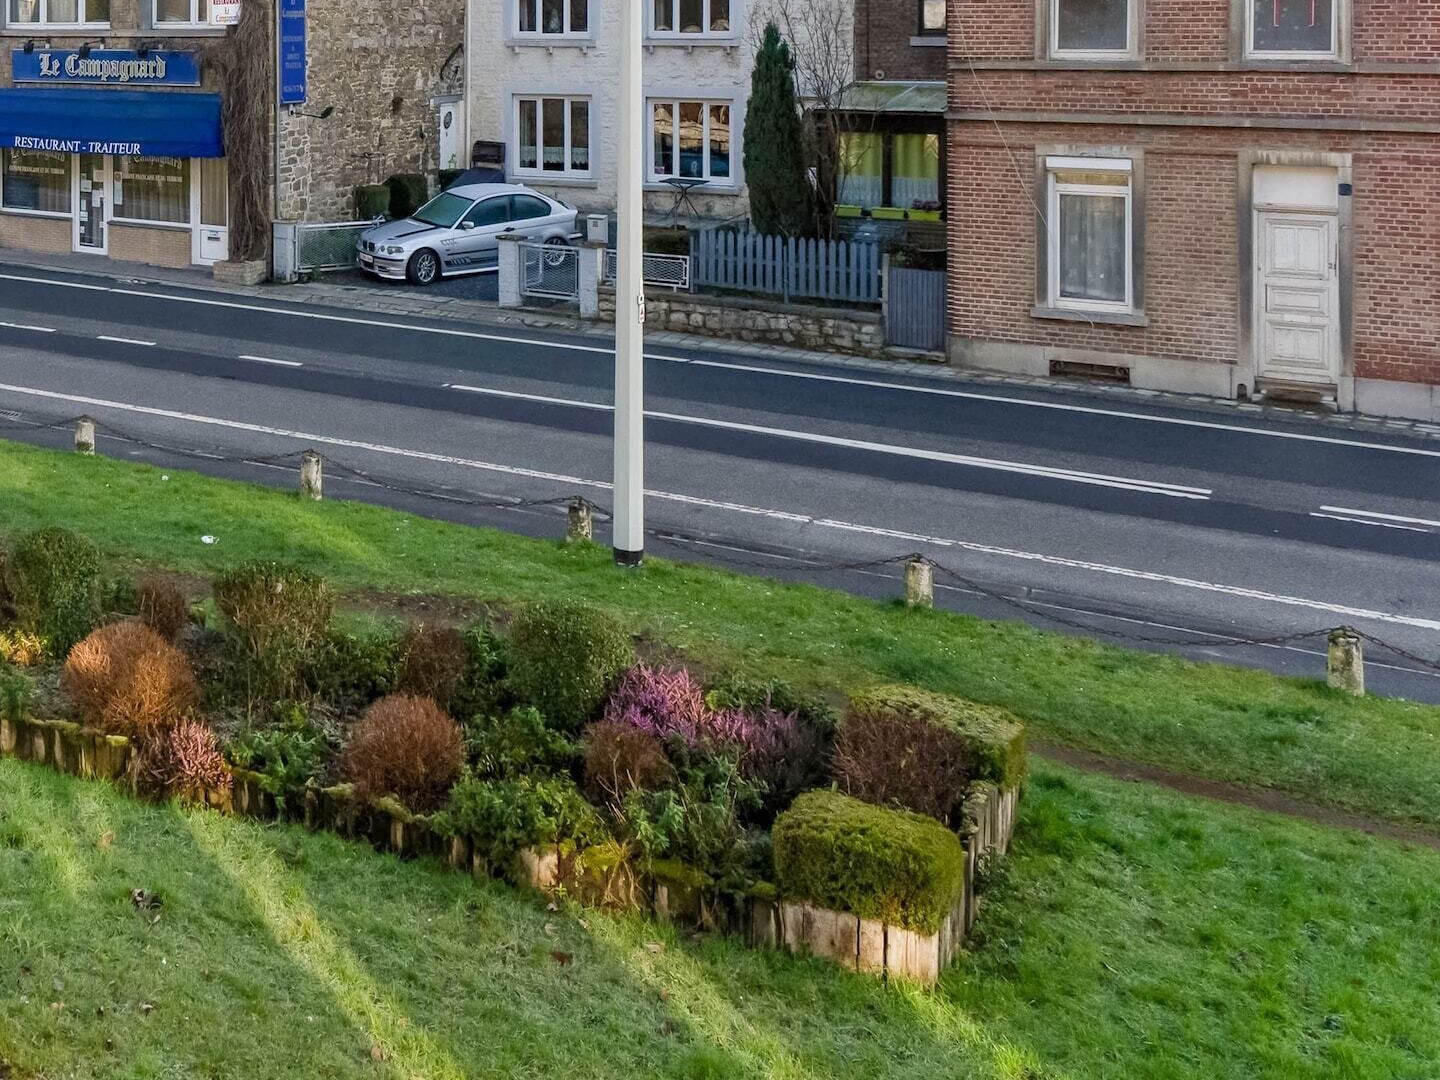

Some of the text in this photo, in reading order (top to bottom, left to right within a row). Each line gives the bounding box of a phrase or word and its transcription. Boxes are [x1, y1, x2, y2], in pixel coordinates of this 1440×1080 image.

[38, 53, 166, 82] Le Campagnard
[14, 136, 81, 152] RESTAURANT
[88, 141, 141, 155] TRAITEUR
